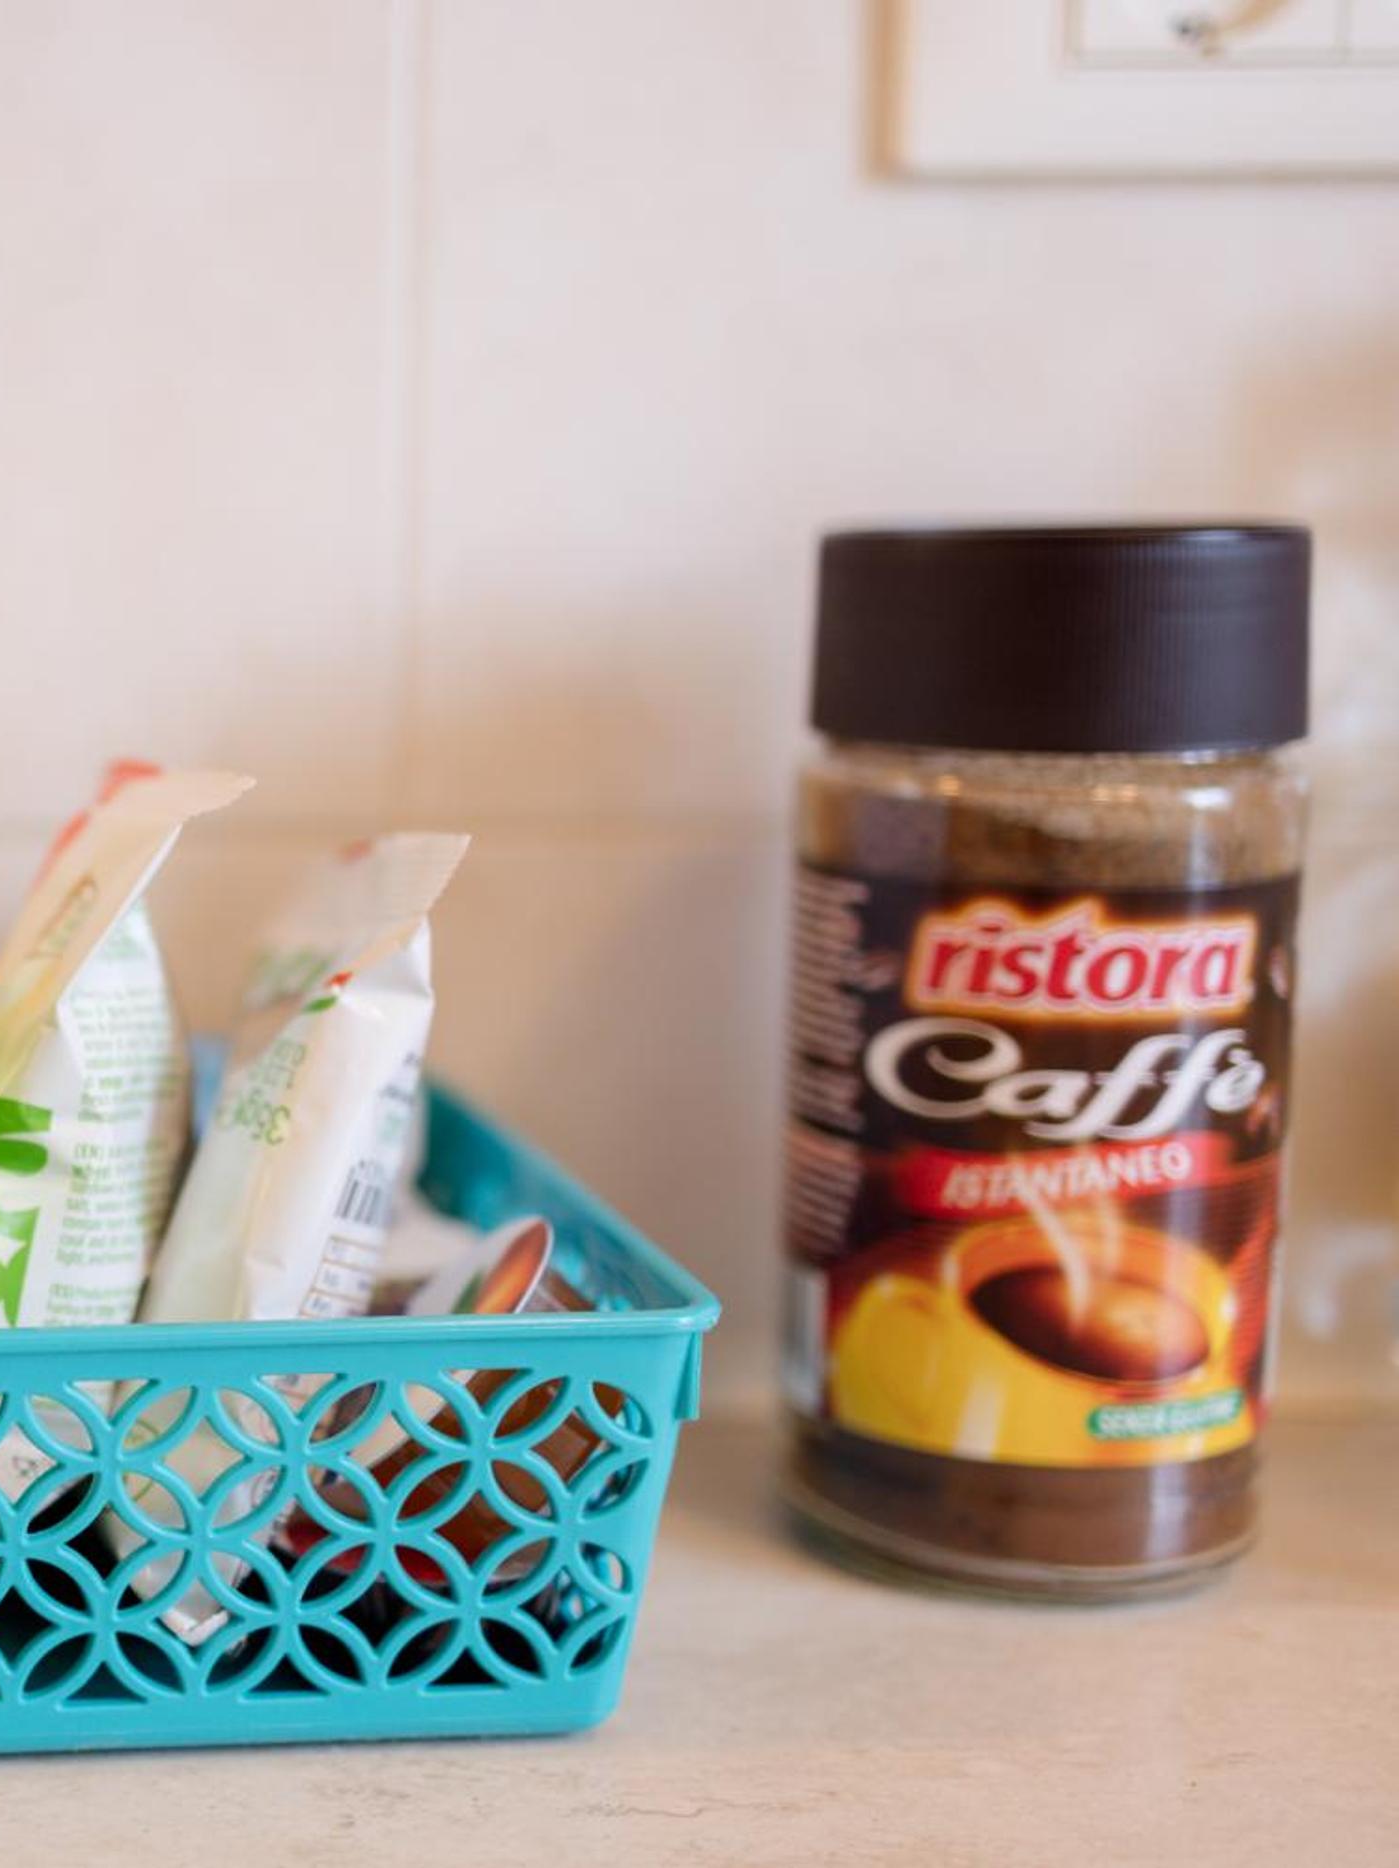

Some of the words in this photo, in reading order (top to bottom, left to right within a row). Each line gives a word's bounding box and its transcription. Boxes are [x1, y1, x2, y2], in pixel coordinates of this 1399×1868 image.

[928, 924, 1237, 1000] ristora
[865, 1016, 1267, 1141] Caffè
[943, 1144, 1192, 1208] ISTANTANEO
